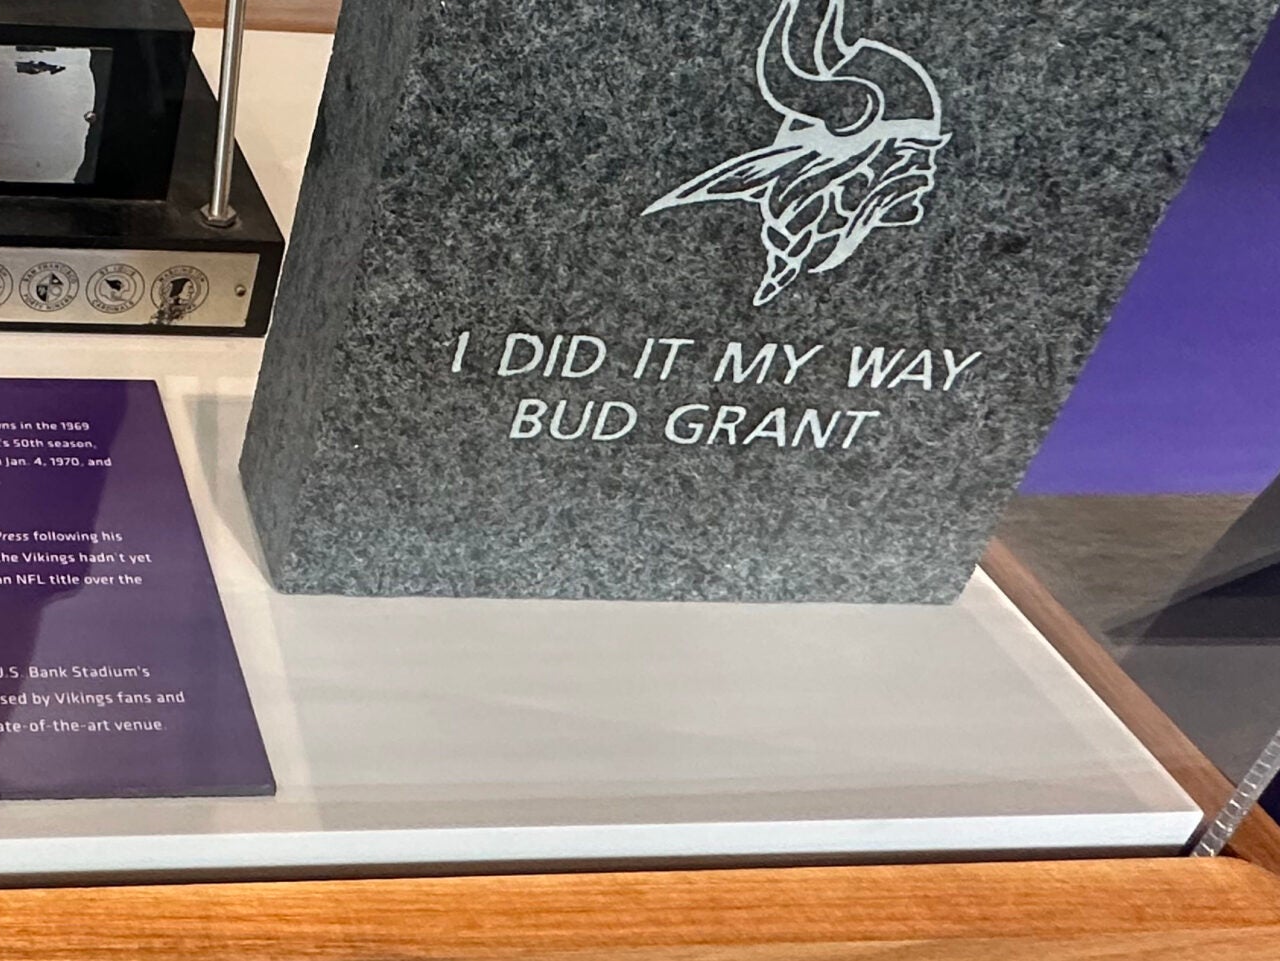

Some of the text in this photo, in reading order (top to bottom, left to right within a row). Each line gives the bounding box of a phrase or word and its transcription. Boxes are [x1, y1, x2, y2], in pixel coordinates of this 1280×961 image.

[451, 331, 981, 391] I DID IT MY WAY
[509, 399, 881, 449] BUD GRANT
[28, 666, 68, 678] Bank
[71, 665, 151, 678] Stadium's
[31, 692, 50, 707] by
[54, 692, 114, 707] Vikings
[116, 691, 152, 704] fans
[156, 691, 185, 703] and
